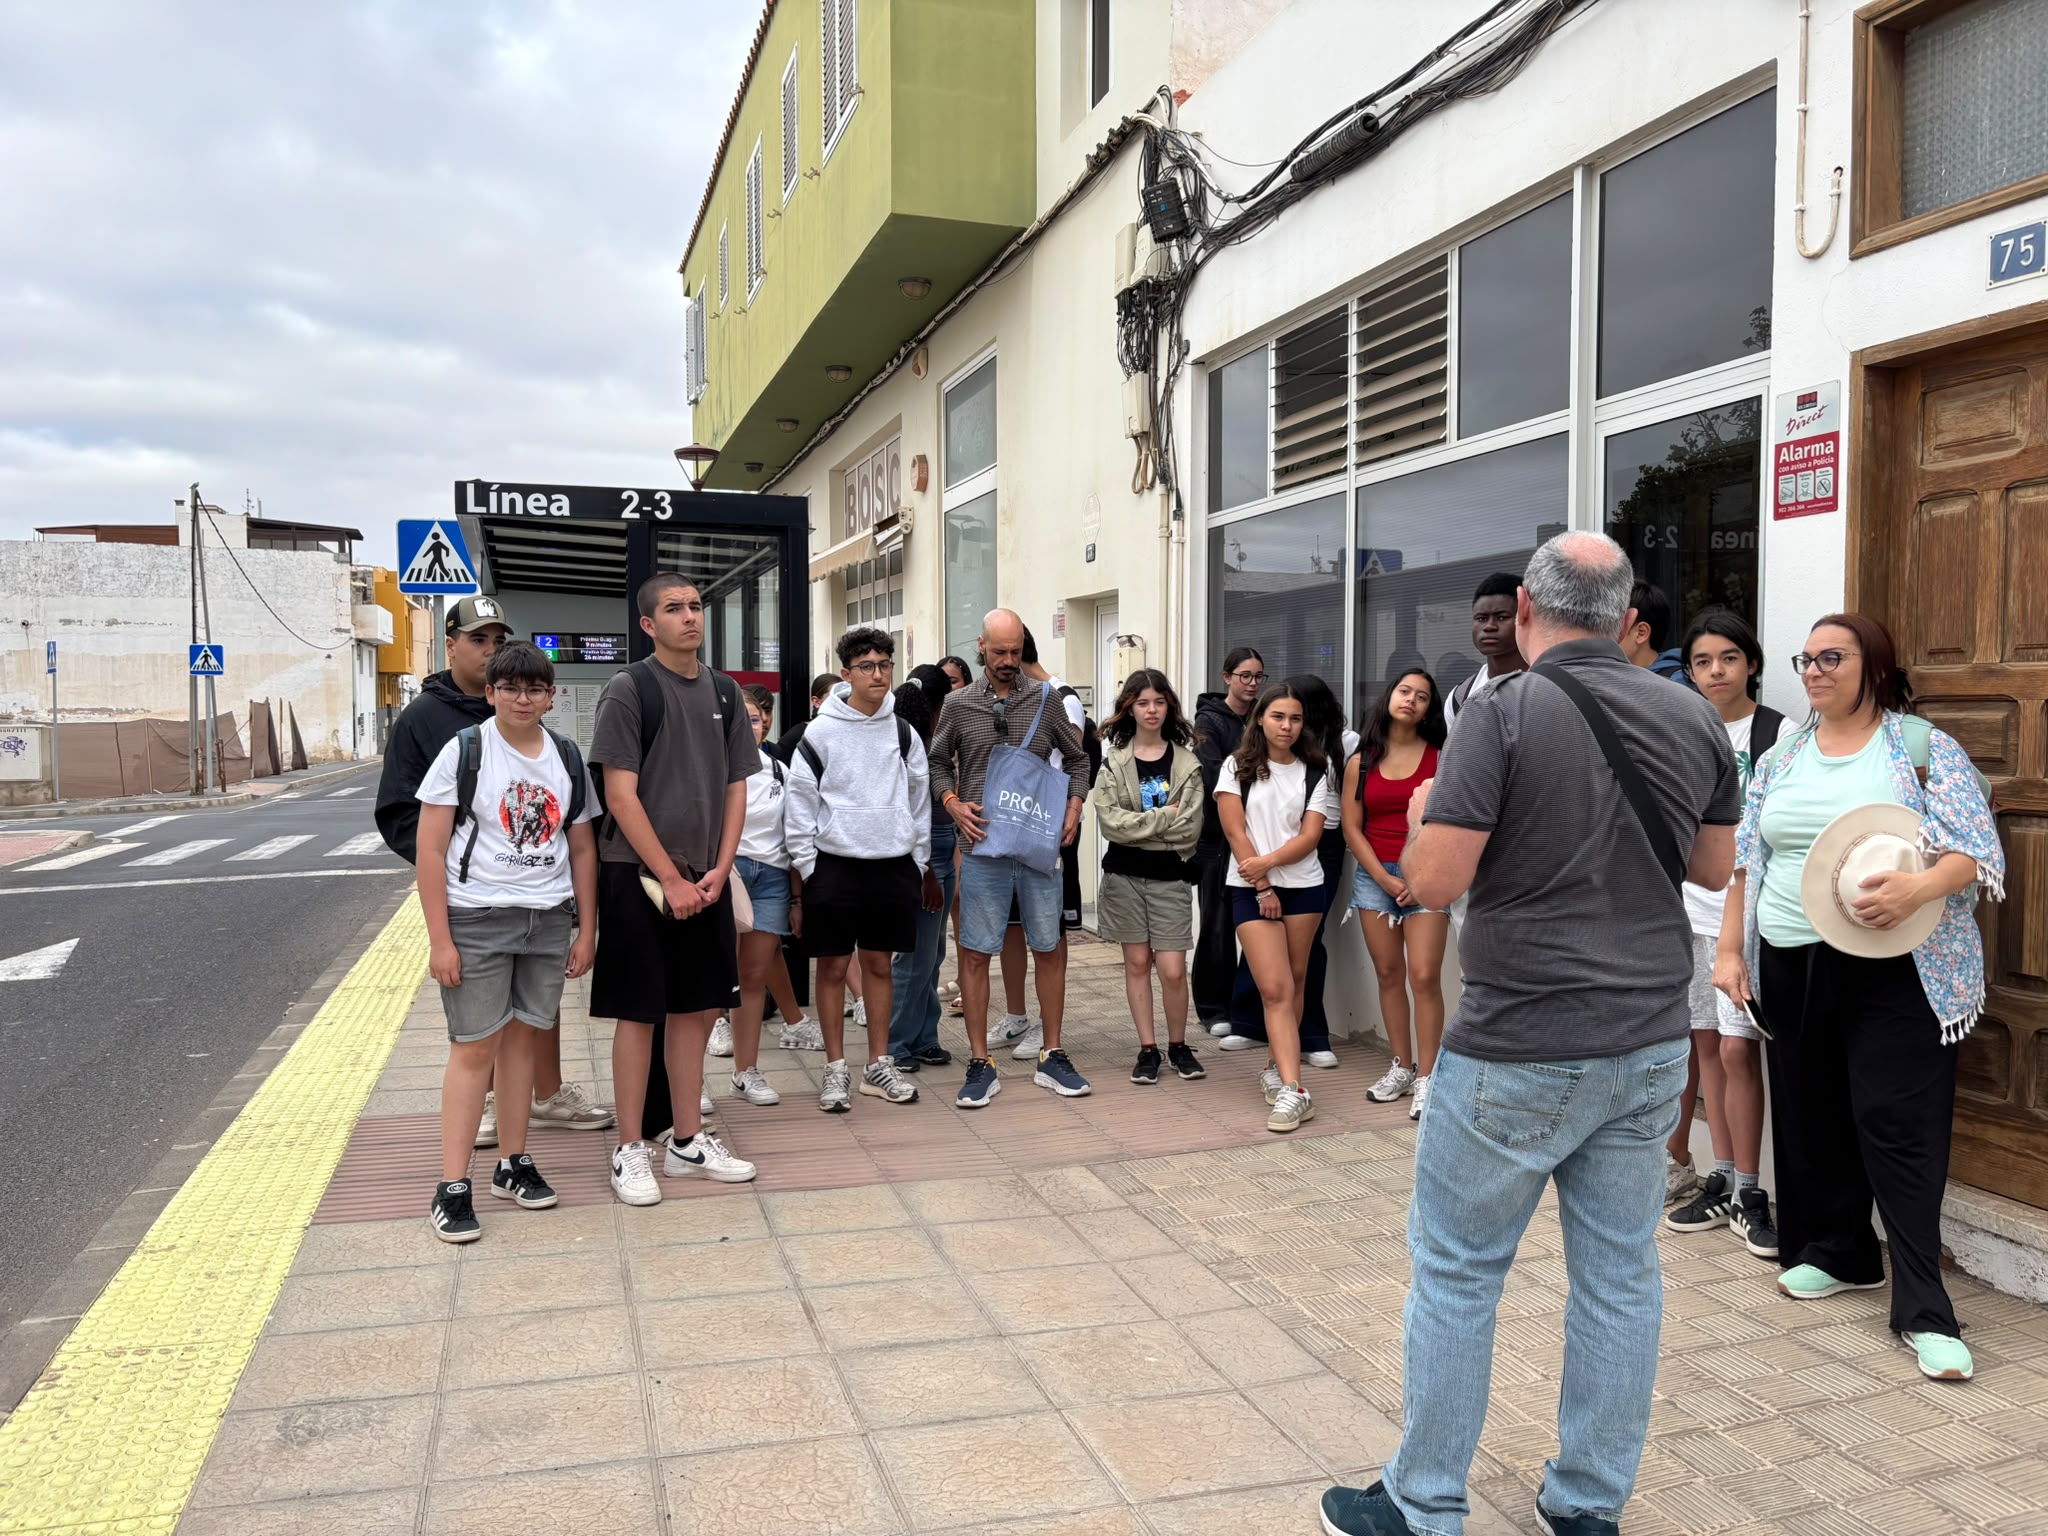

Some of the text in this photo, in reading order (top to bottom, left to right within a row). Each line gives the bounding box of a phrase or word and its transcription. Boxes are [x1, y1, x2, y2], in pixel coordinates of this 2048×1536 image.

[2000, 233, 2034, 273] 75
[1785, 404, 1829, 436] Direct
[1779, 440, 1834, 464] Alarma
[1791, 462, 1806, 471] aviso
[466, 483, 673, 520] Línea 2-3
[545, 637, 553, 647] 2
[546, 650, 553, 659] 3
[998, 790, 1051, 821] PROA+
